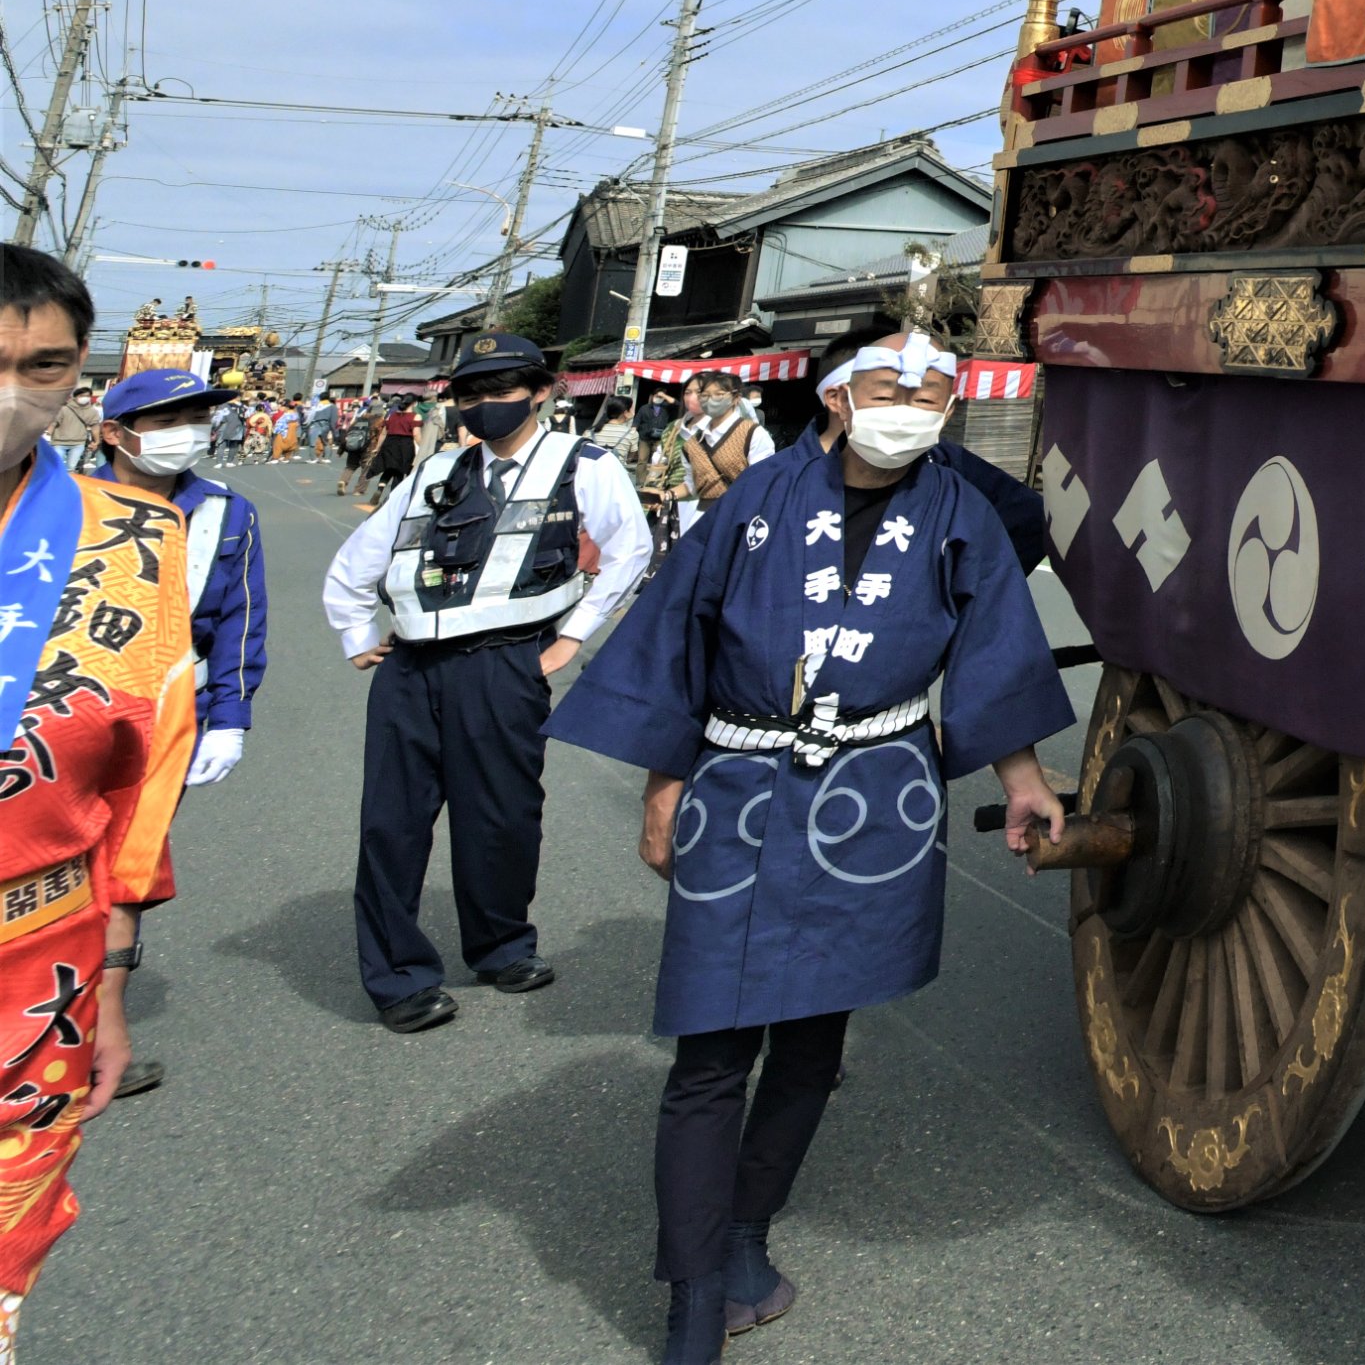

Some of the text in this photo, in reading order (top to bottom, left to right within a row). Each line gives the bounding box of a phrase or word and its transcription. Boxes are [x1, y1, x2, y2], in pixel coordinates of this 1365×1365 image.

[0, 537, 54, 699] 大手
[830, 515, 916, 664] 大手町
